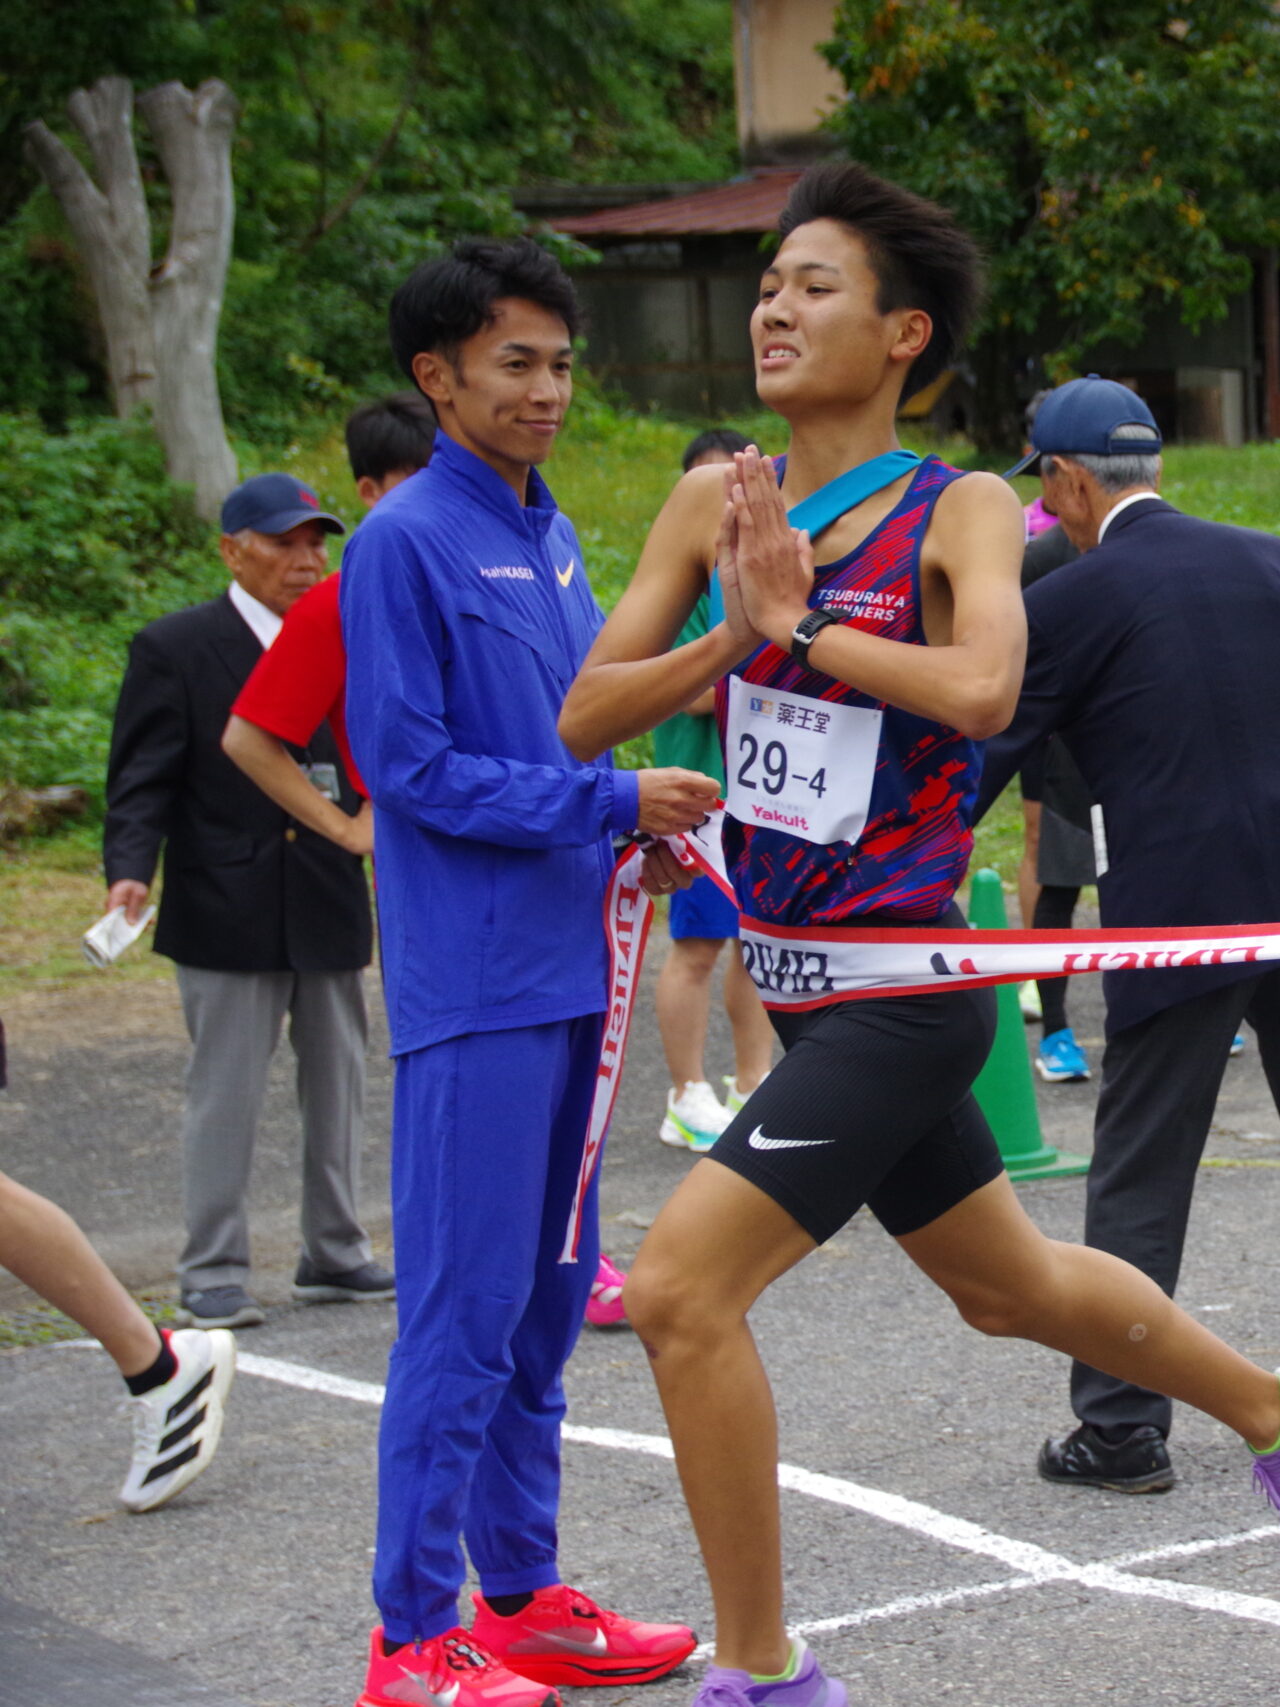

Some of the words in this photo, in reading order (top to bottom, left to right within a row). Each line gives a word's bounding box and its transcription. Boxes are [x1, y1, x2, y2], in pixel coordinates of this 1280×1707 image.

[817, 589, 906, 609] TSUBURAYA
[776, 702, 831, 734] 薬王堂
[737, 732, 827, 799] 29-4
[751, 804, 809, 831] Yakult
